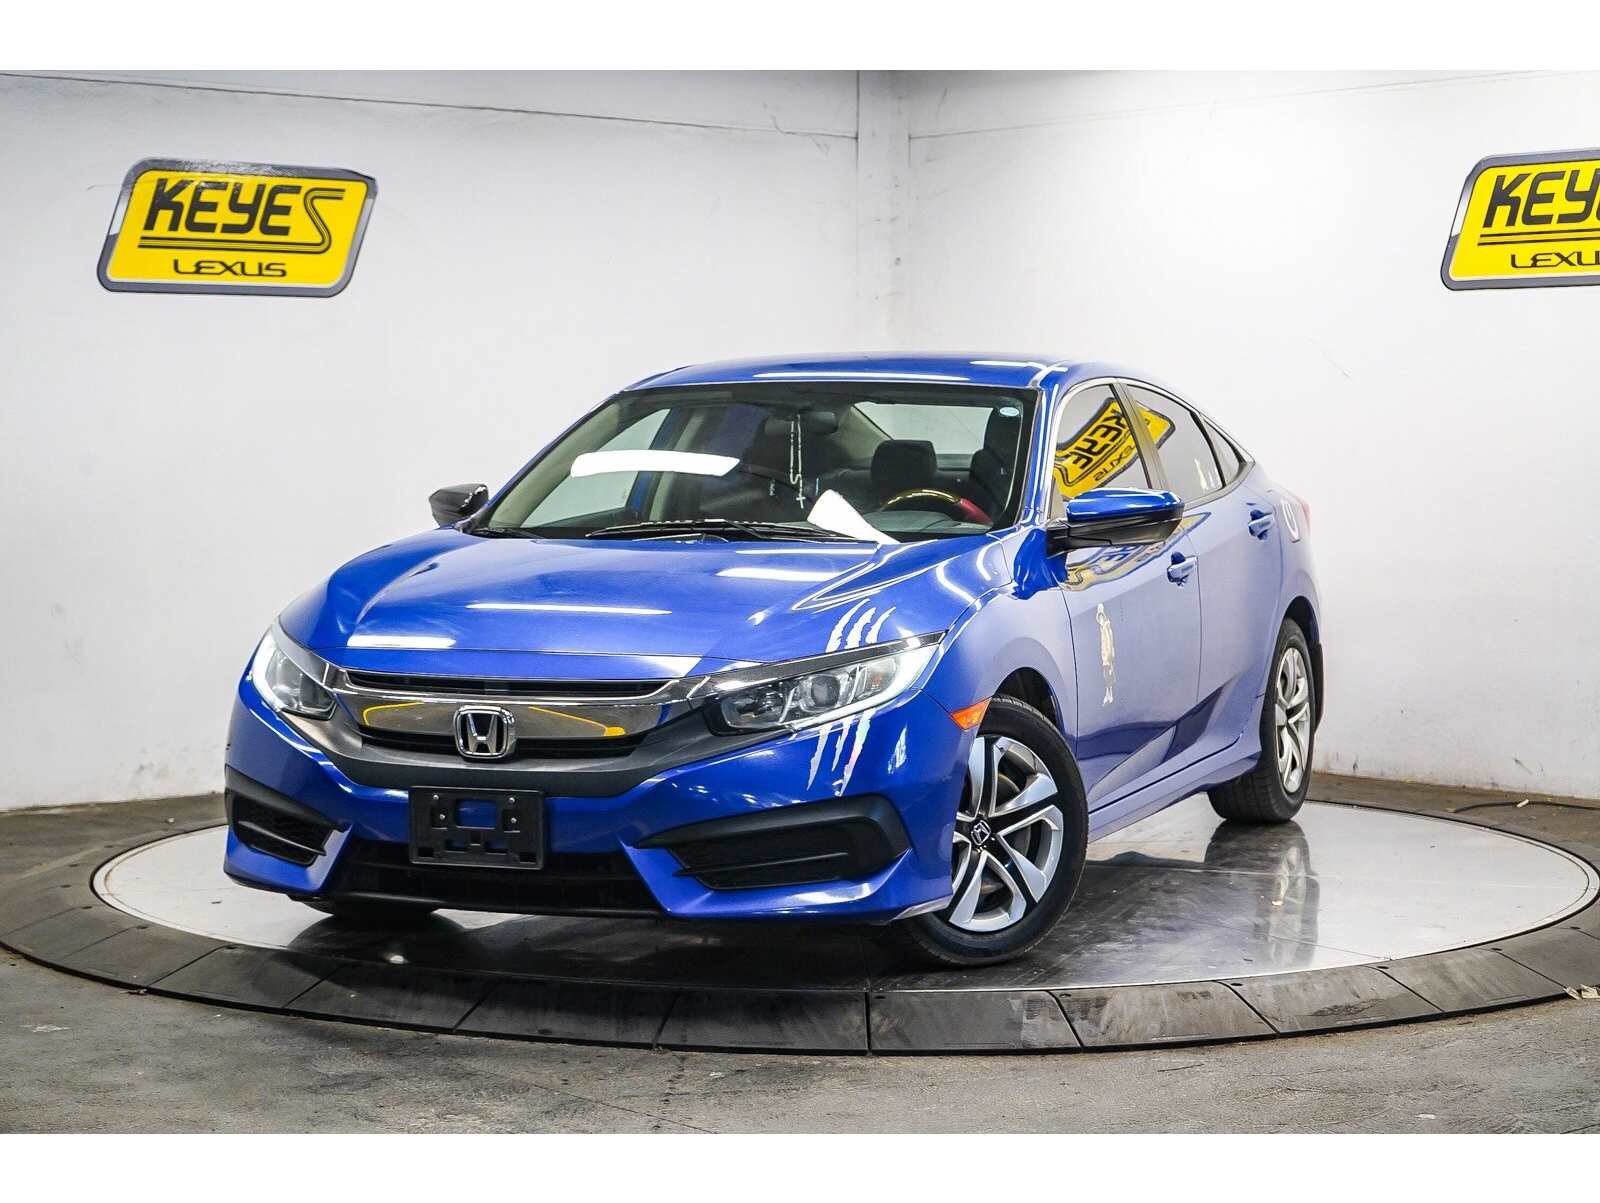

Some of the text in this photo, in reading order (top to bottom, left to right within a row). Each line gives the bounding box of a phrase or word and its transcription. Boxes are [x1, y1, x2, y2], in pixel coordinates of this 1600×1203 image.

[141, 177, 346, 253] KEYES
[1482, 168, 1600, 228] KEY
[173, 258, 287, 277] LEXUS
